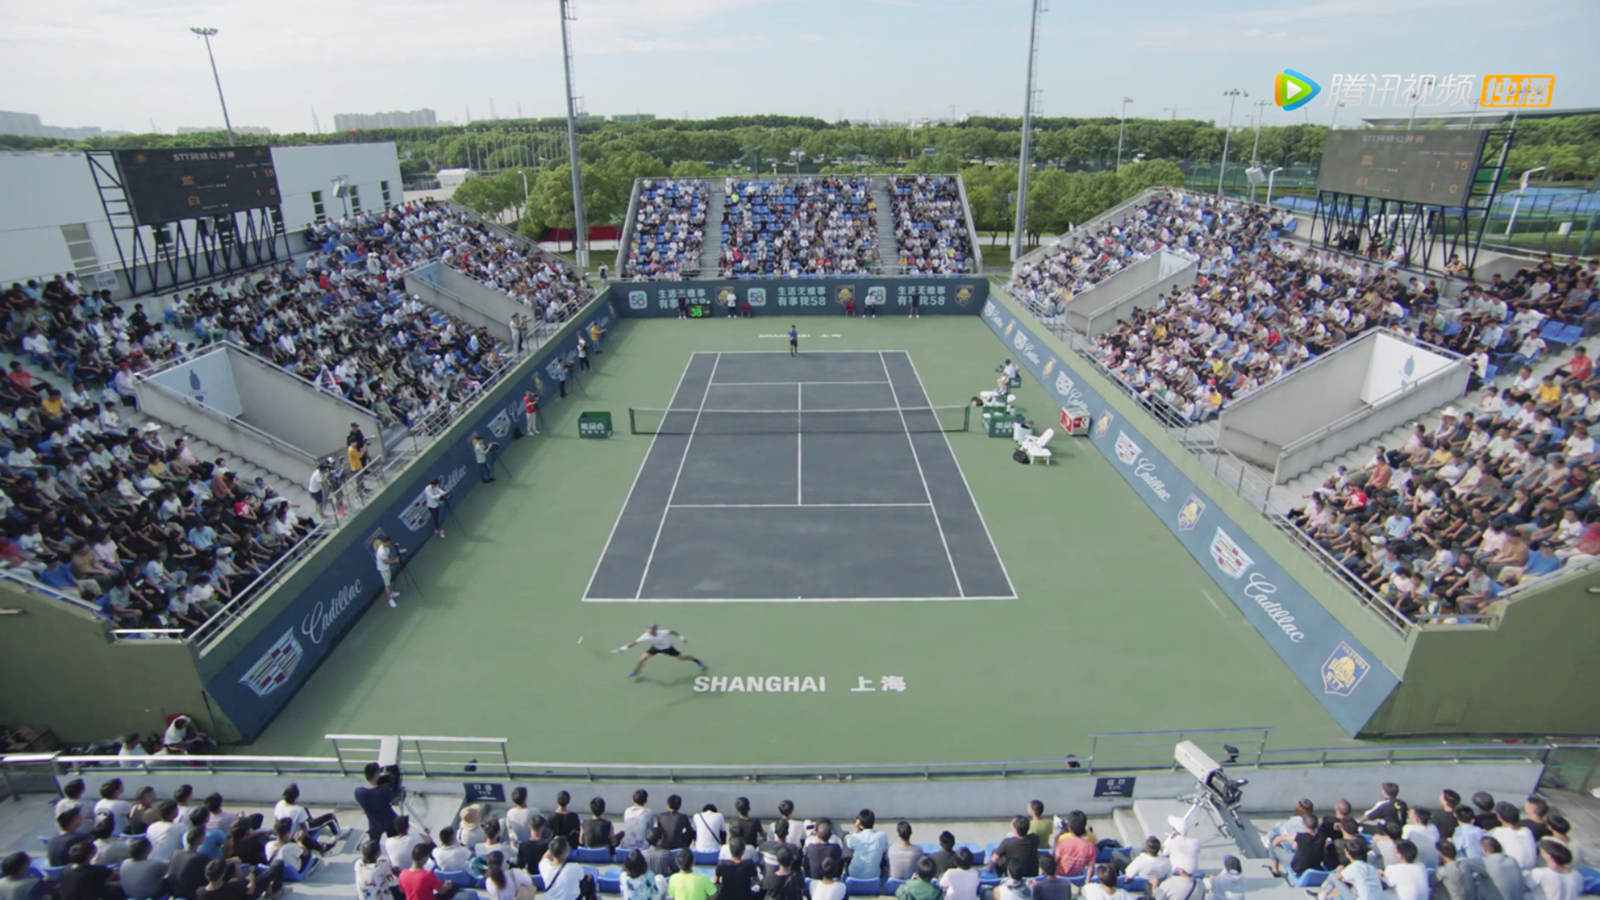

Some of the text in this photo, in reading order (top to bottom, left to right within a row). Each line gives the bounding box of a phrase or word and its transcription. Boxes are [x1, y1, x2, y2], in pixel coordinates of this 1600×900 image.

[1435, 160, 1470, 170] 1 15
[264, 169, 274, 177] 15
[1449, 184, 1458, 193] 0
[750, 290, 764, 304] 58
[778, 296, 826, 307] 有事找58
[691, 307, 703, 318] 38
[1133, 457, 1171, 502] Cadillac
[302, 579, 363, 644] Cadillac
[1244, 572, 1304, 643] Cadillac
[693, 675, 826, 693] SHANGHAI
[850, 675, 907, 692] 上海
